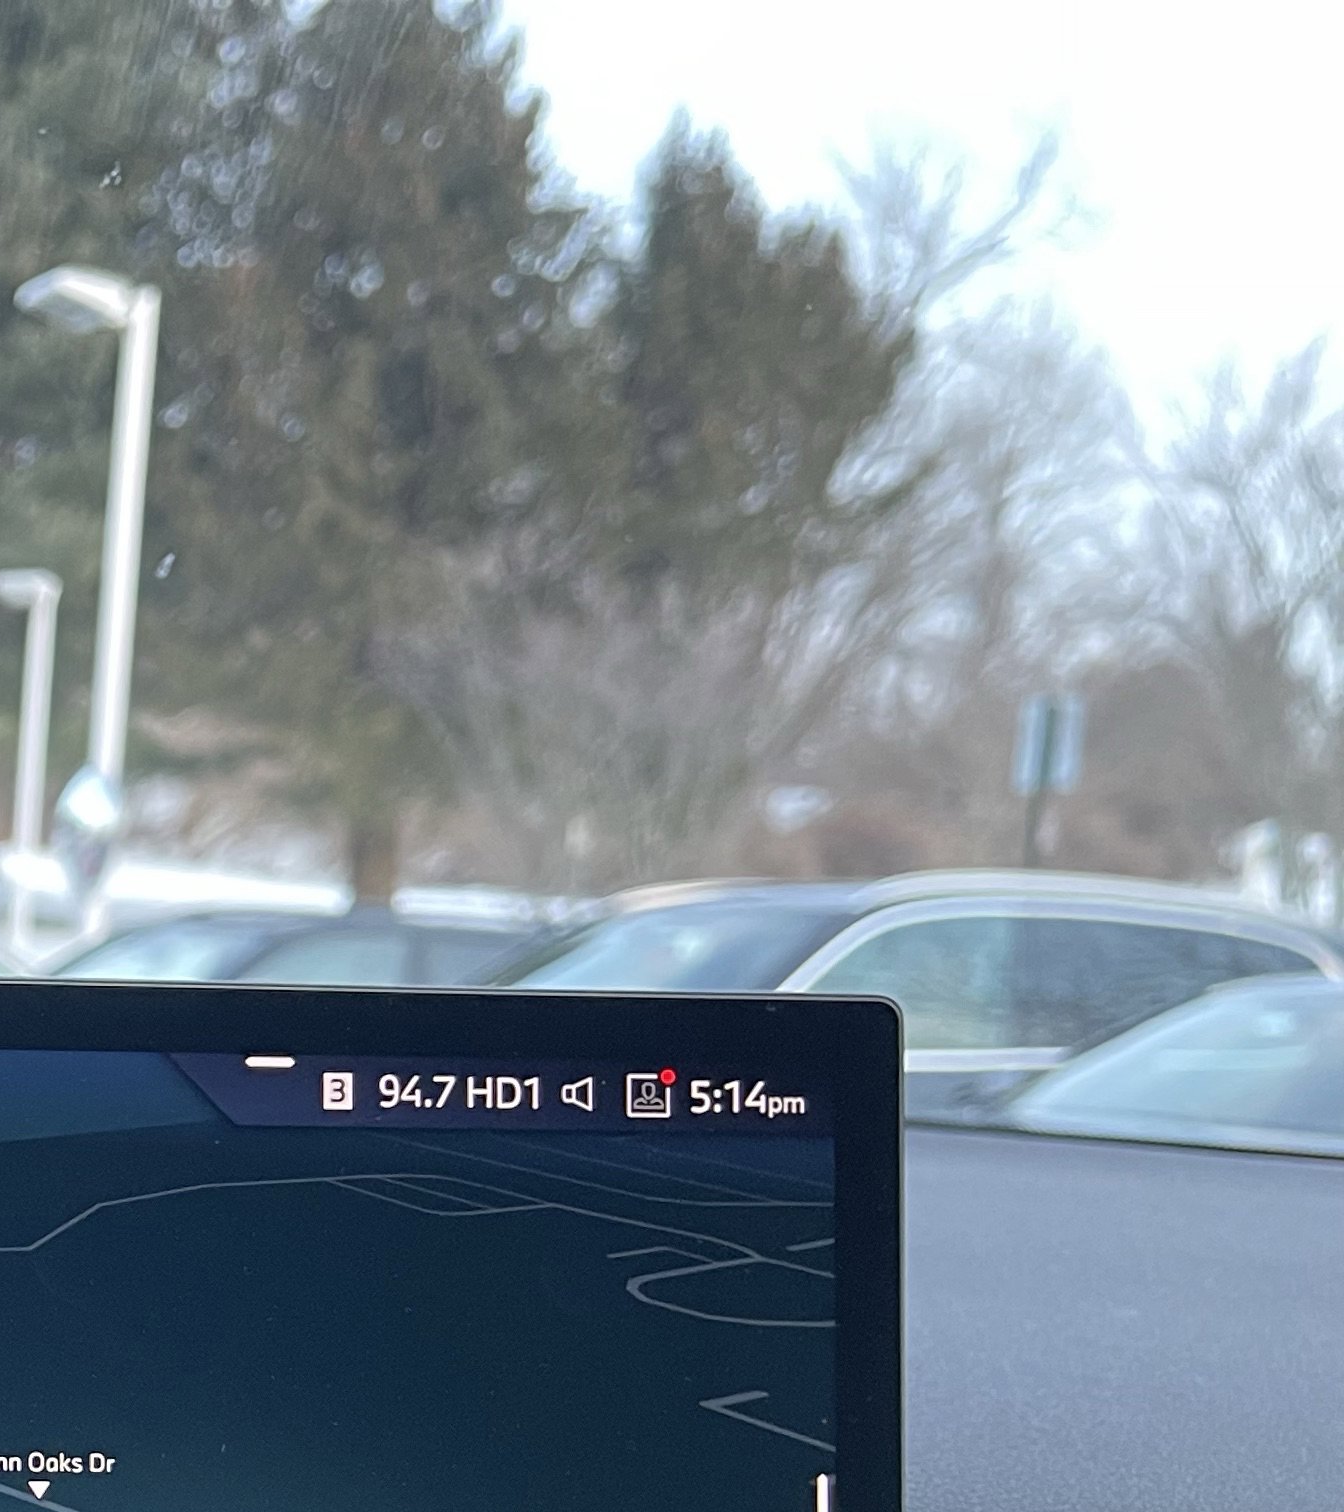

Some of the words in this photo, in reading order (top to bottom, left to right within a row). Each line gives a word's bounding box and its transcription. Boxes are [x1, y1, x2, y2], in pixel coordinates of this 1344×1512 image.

[378, 1073, 457, 1109] 94.7
[467, 1076, 540, 1110] HD1
[28, 1451, 84, 1474] Oaks
[89, 1452, 116, 1473] Dr
